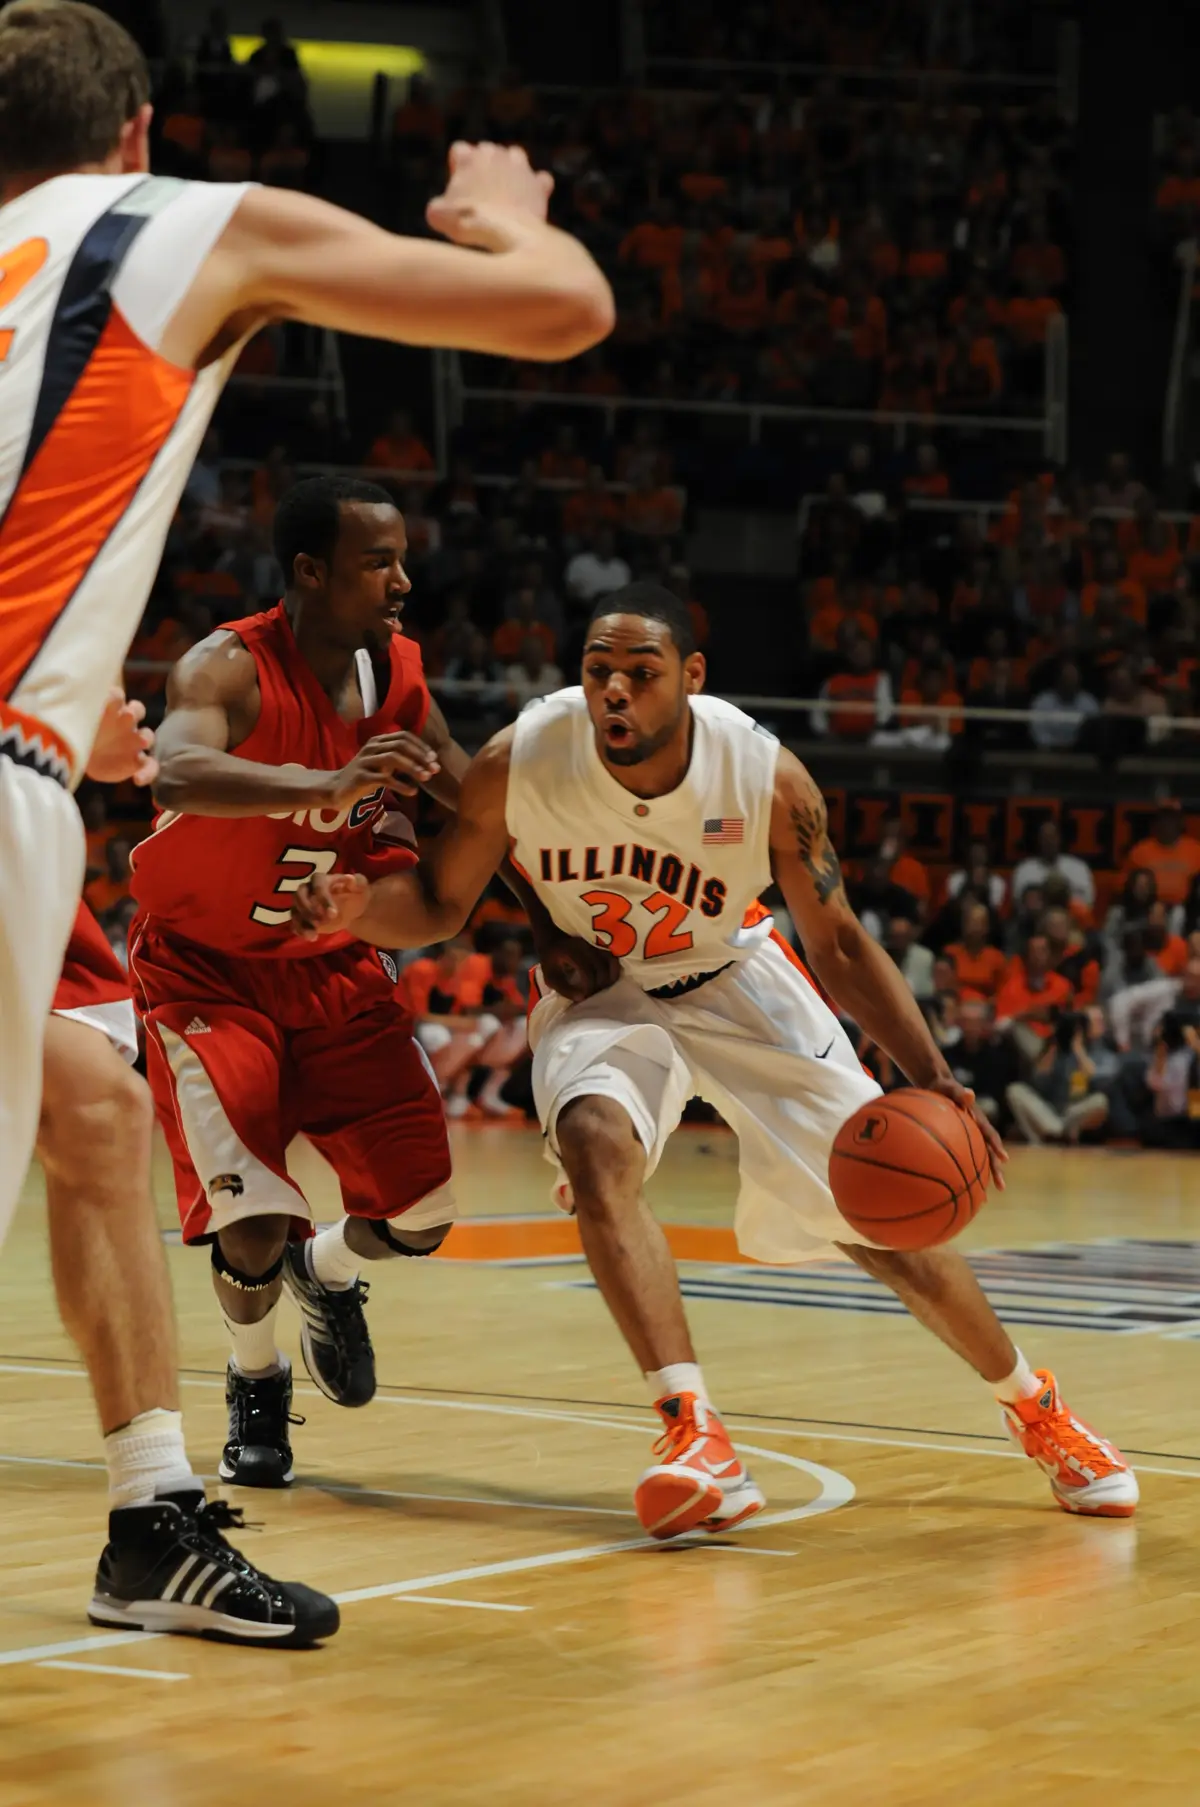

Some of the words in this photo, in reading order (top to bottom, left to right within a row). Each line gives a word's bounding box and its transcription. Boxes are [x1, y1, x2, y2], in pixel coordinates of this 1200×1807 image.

[249, 844, 338, 927] 3
[539, 843, 728, 918] ILLINOIS
[579, 889, 694, 960] 32
